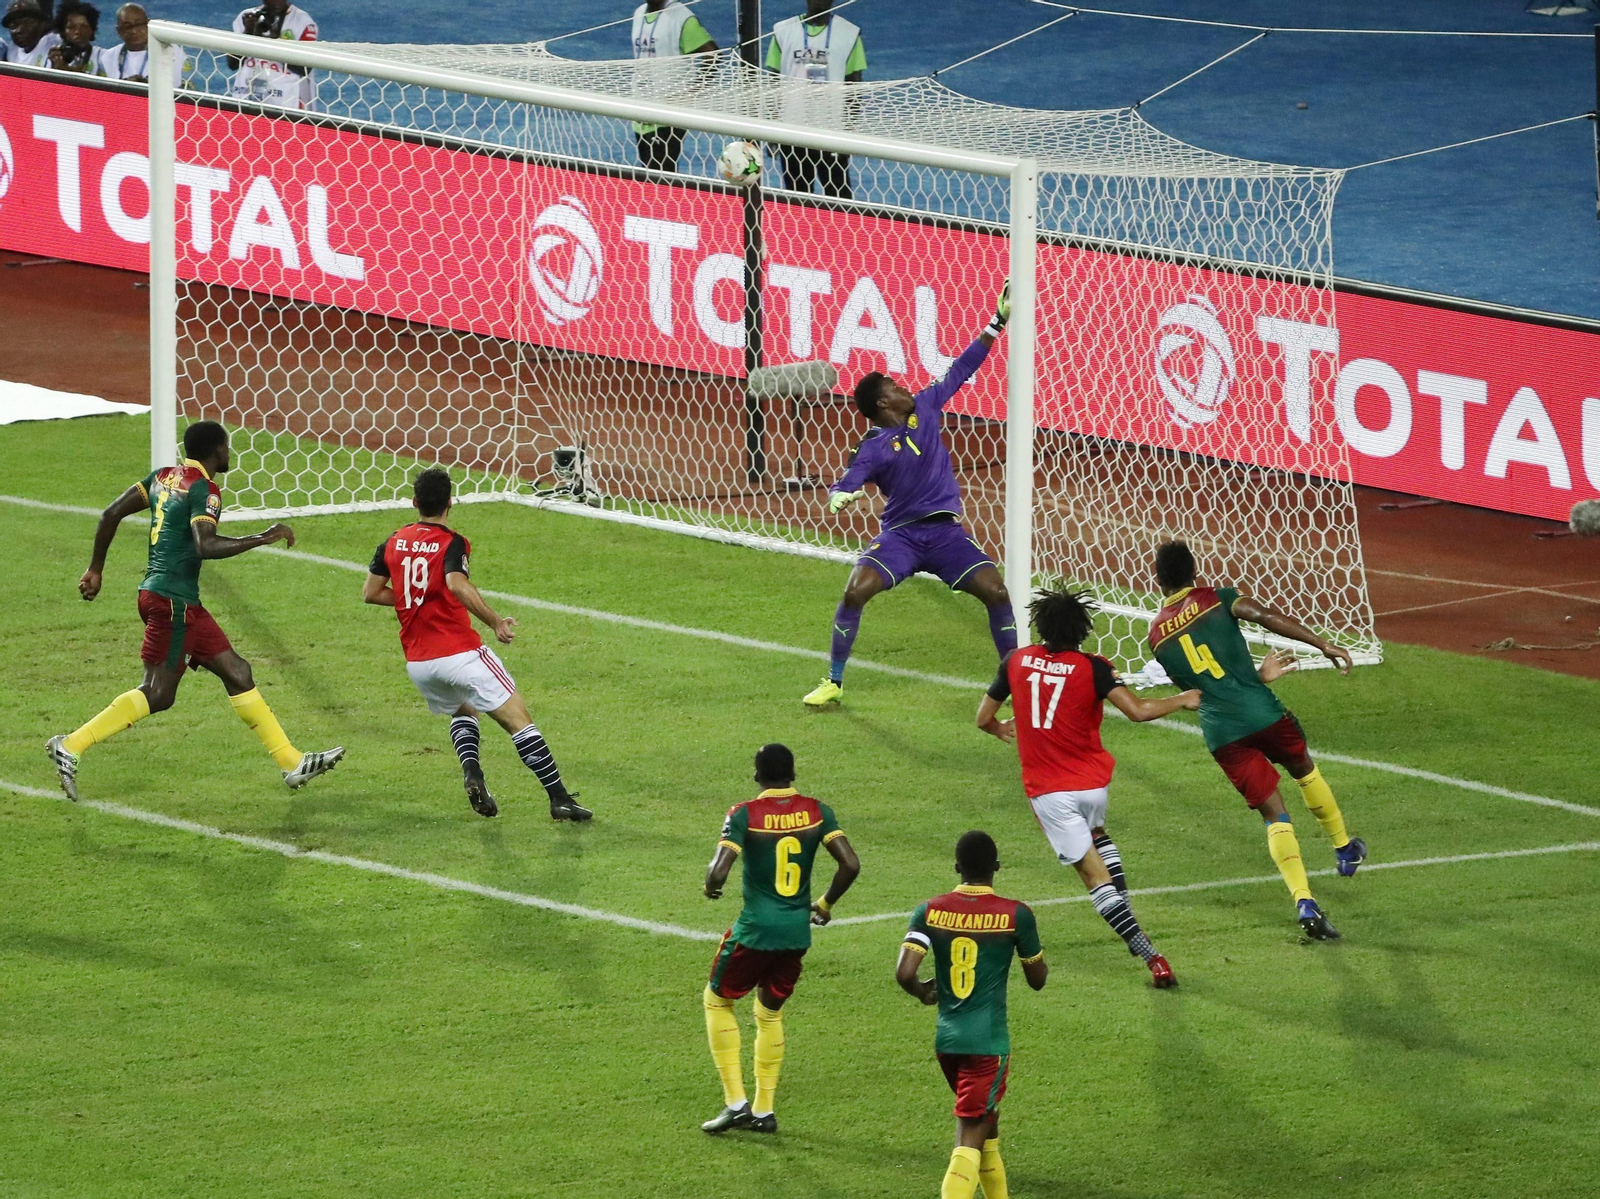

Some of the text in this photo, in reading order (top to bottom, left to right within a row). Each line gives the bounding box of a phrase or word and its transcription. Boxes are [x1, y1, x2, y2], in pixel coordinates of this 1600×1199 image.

[32, 114, 365, 281] TOTAL
[623, 214, 976, 386] TOTAL
[905, 436, 922, 456] 1
[395, 539, 409, 552] EL
[400, 556, 429, 610] 19
[1158, 601, 1200, 637] TEIKEU
[1178, 633, 1226, 680] 4
[1026, 671, 1067, 730] 17
[763, 810, 811, 830] OYONGO
[774, 835, 803, 898] 6
[926, 908, 1011, 929] MOUKANDJO
[949, 936, 979, 1000] 8
